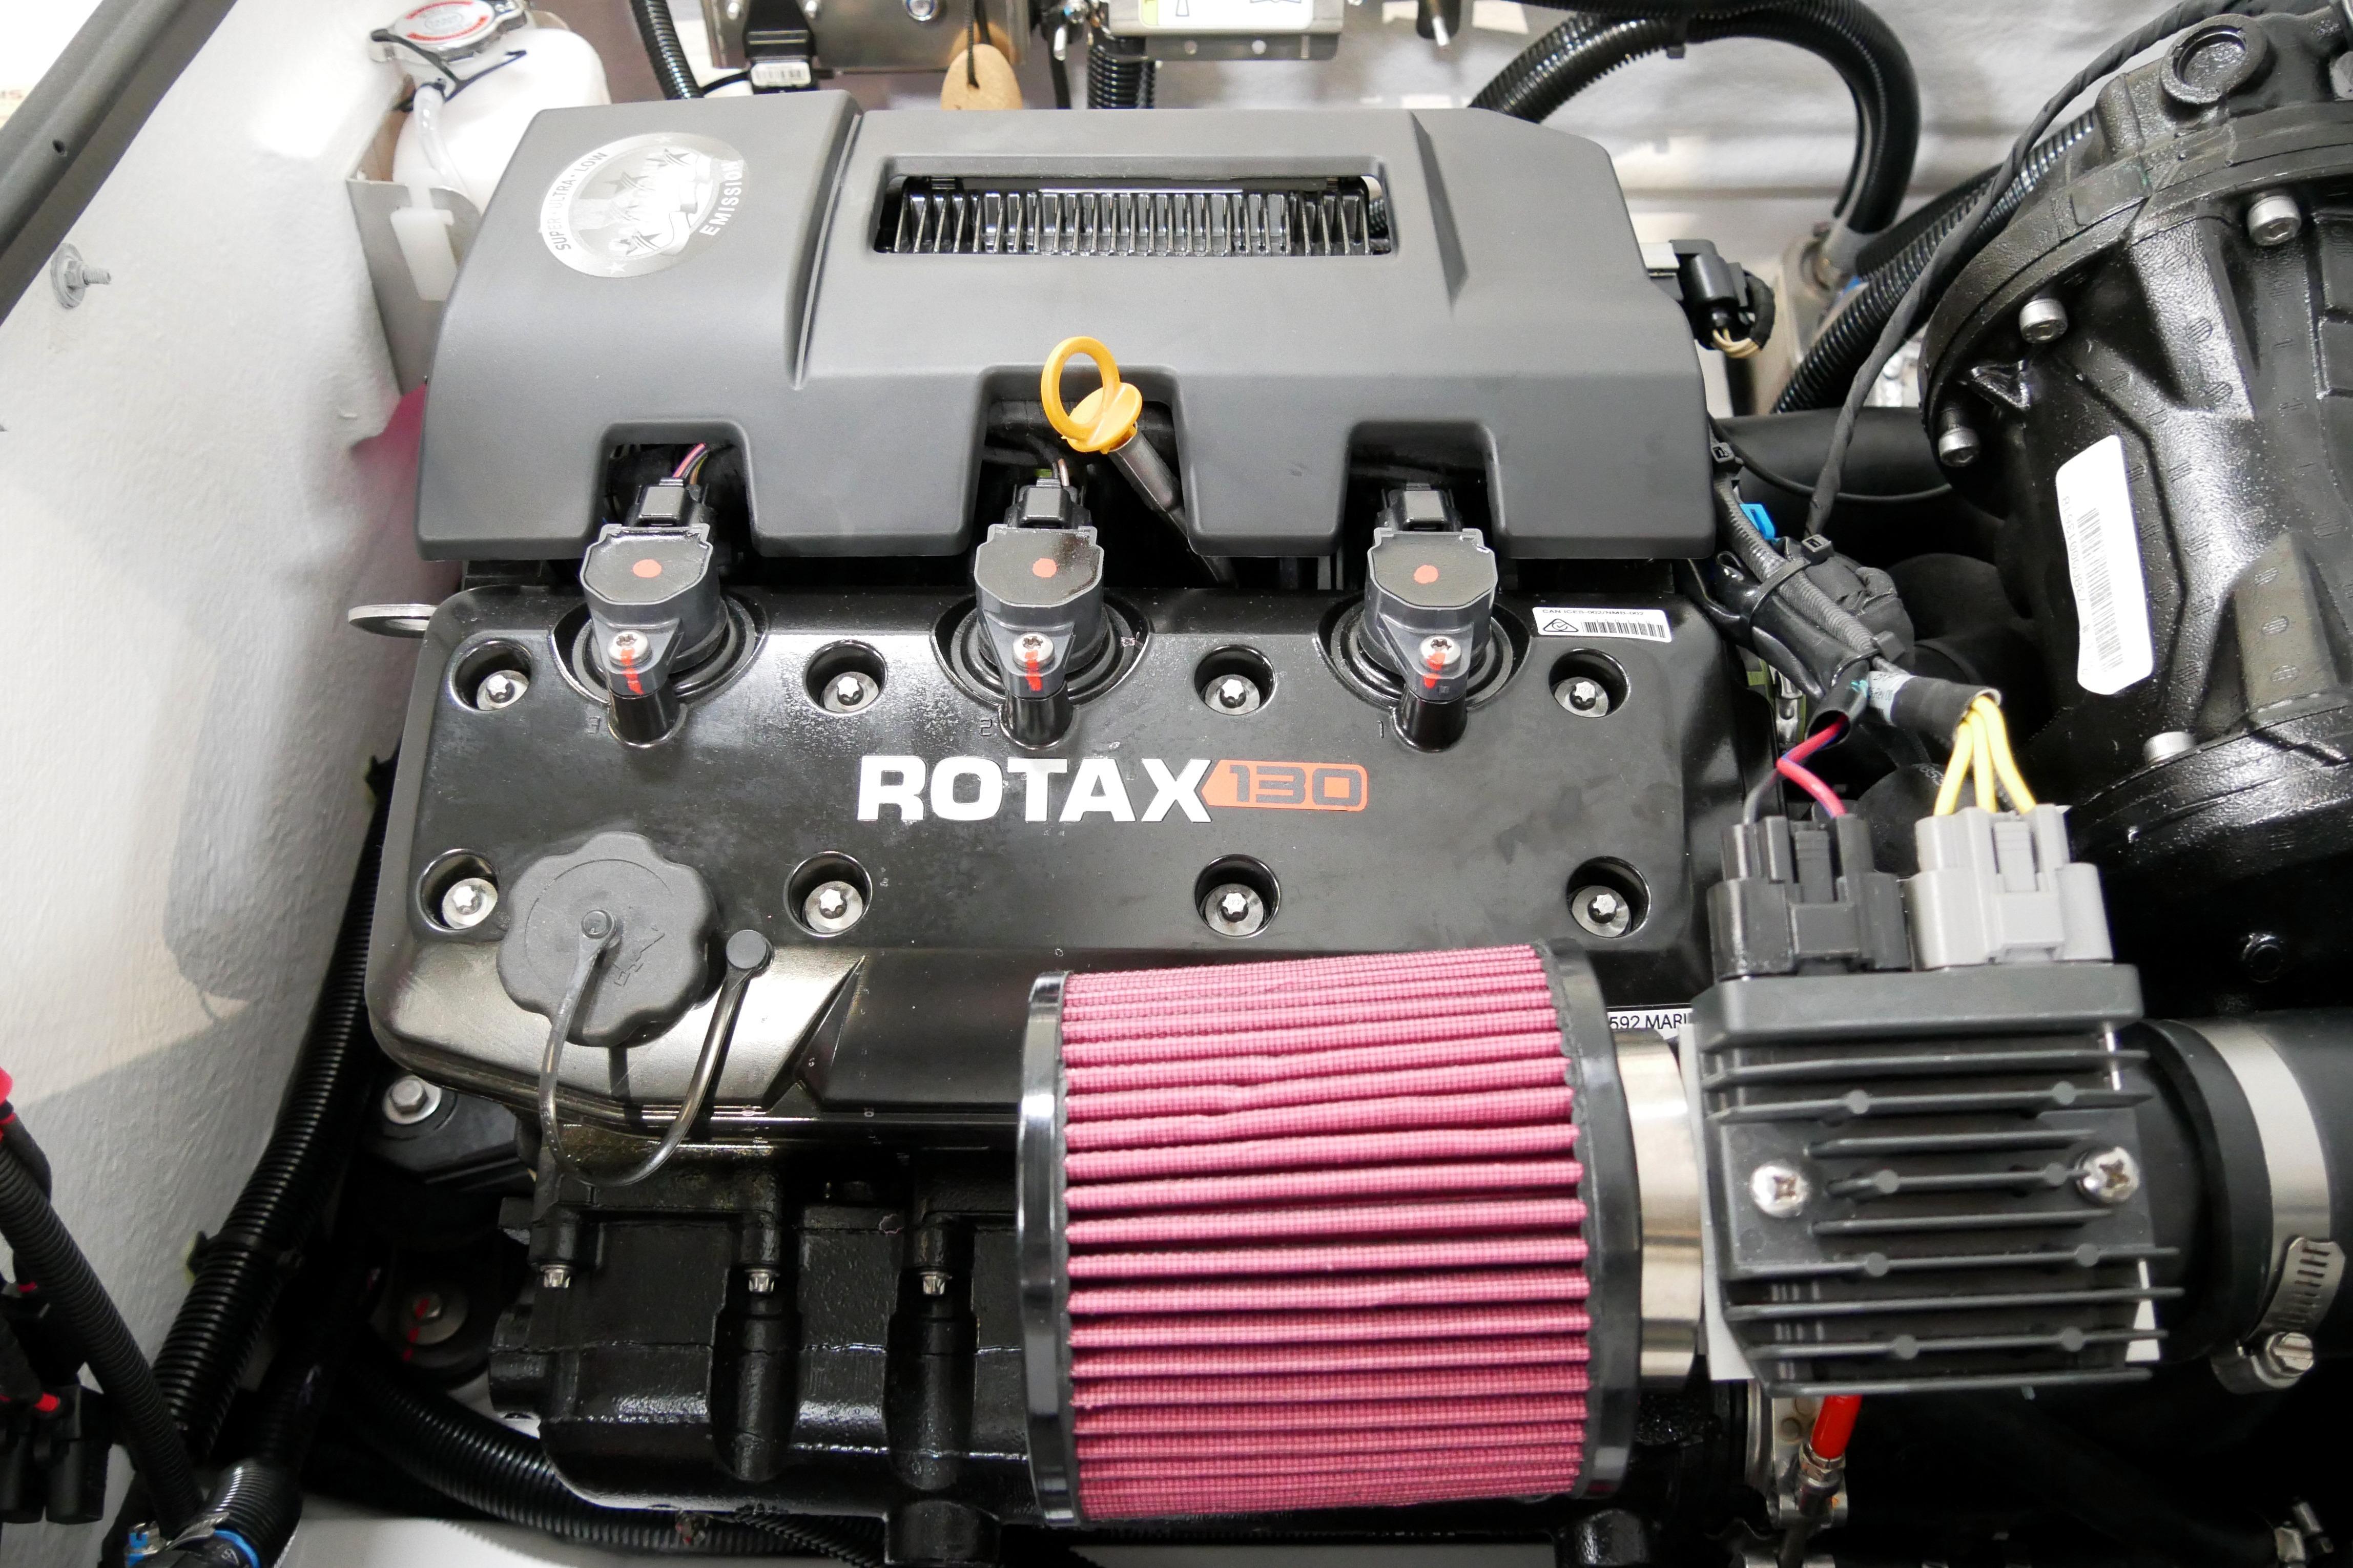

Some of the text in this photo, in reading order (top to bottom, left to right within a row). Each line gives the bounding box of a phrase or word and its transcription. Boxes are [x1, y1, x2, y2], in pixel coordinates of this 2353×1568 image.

[547, 152, 608, 250] SUPER ULTRA LOW
[699, 160, 743, 236] EMISSION
[857, 755, 1361, 823] ROTAX 130
